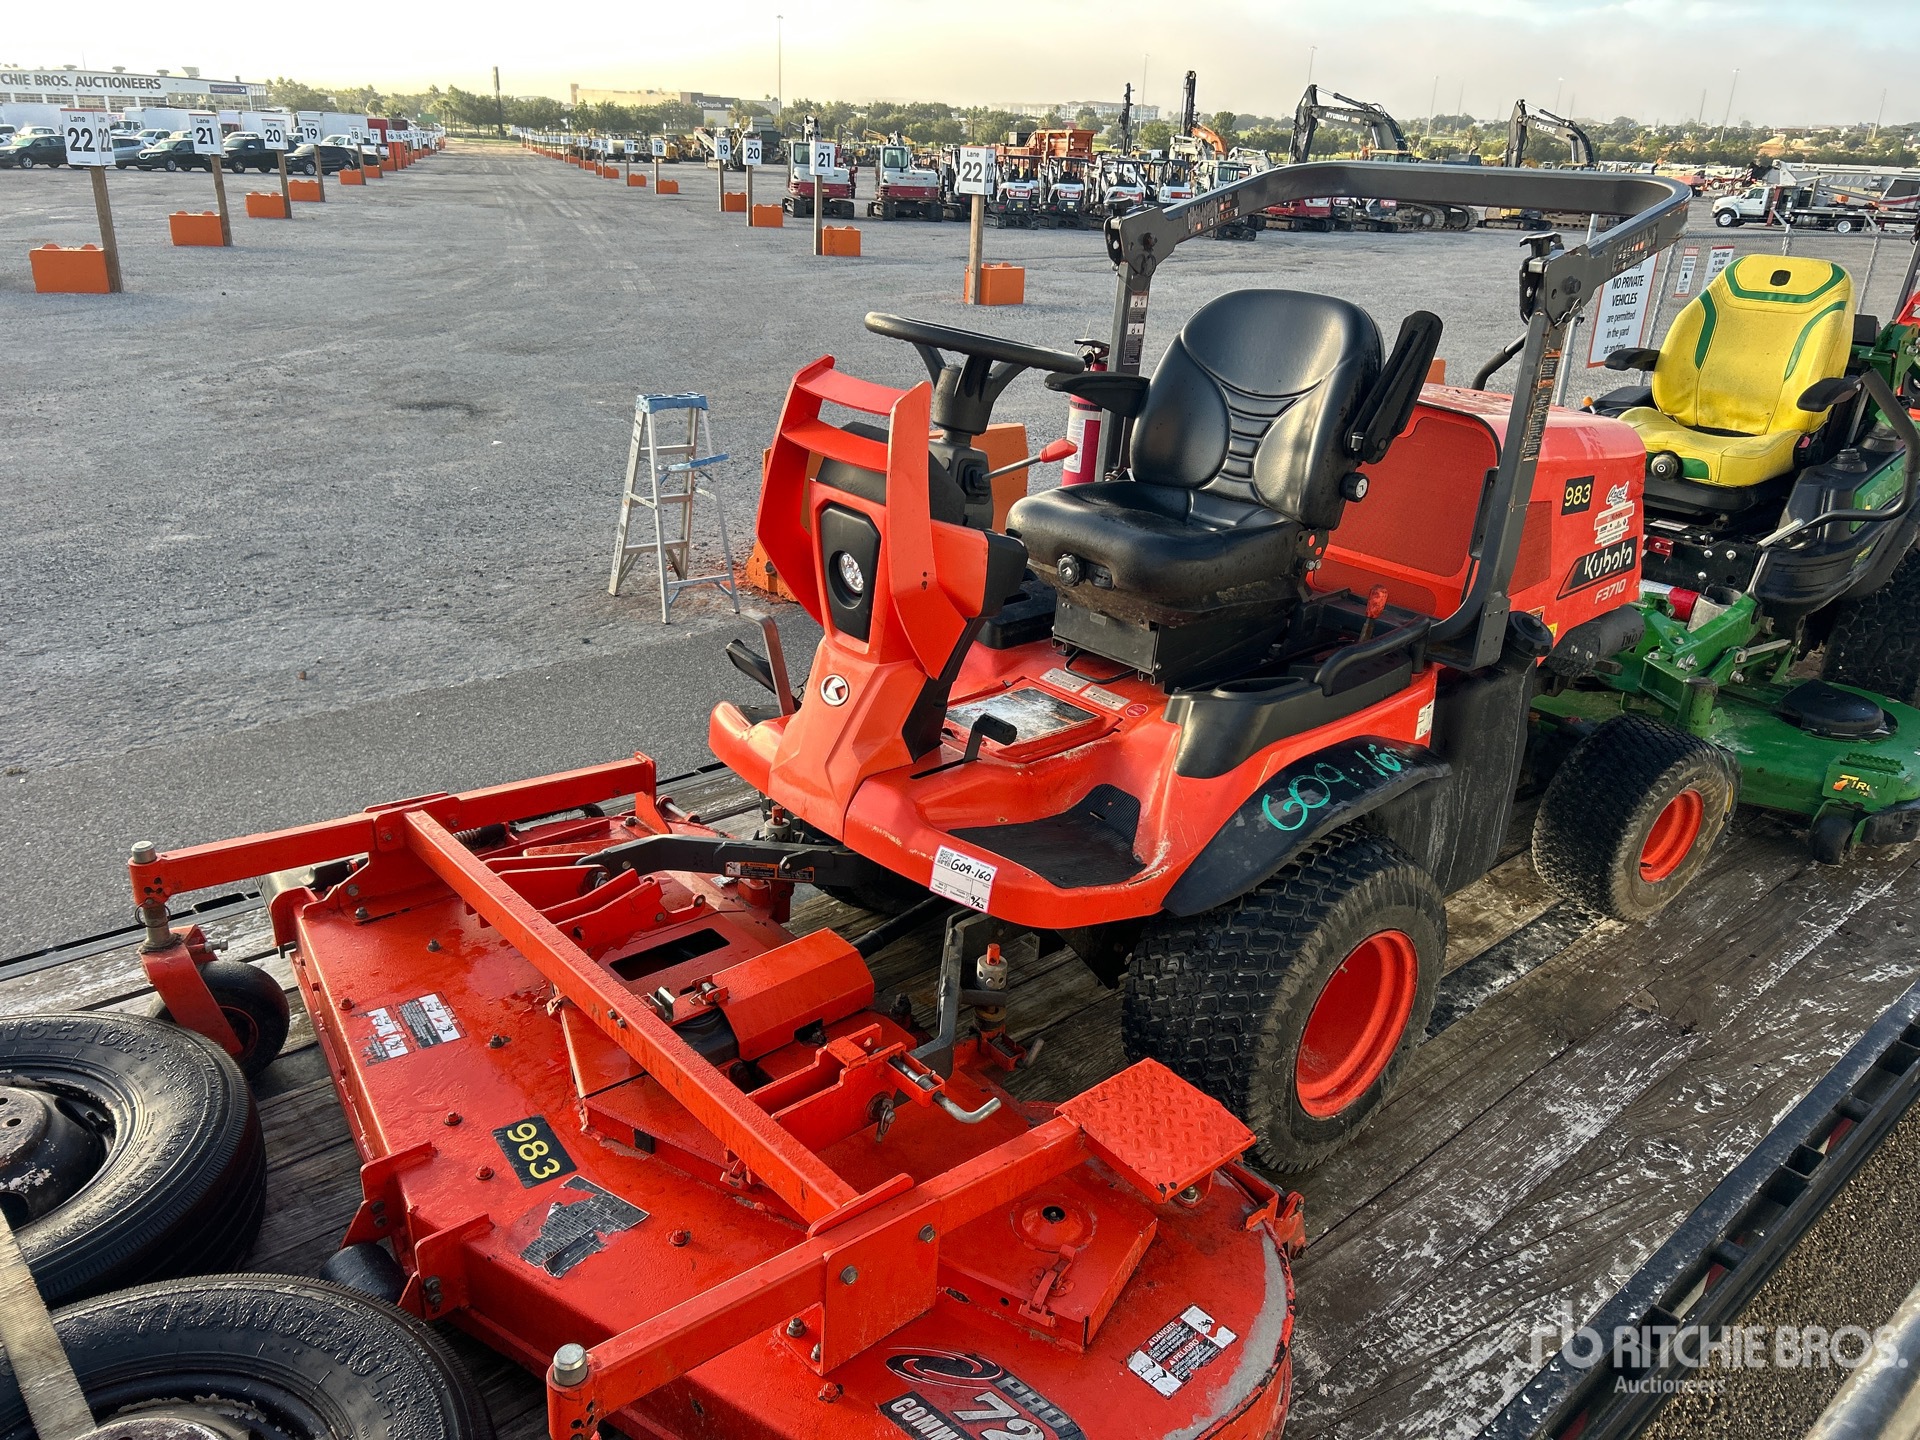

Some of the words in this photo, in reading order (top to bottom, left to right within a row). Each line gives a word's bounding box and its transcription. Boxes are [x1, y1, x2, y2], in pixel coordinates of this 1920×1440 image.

[34, 74, 72, 87] BROS.
[75, 76, 162, 90] AUCTIONEERS
[69, 114, 86, 123] Lane
[1325, 111, 1350, 122] HYUNDAI
[195, 126, 214, 145] 21
[265, 129, 281, 143] 20
[305, 127, 318, 140] 19
[351, 131, 359, 140] 18
[1534, 122, 1557, 135] DEERE
[67, 127, 96, 153] 22
[98, 128, 113, 153] 22
[626, 143, 633, 151] 17
[655, 144, 663, 153] 18
[719, 144, 729, 155] 19
[747, 147, 760, 160] 20
[966, 150, 980, 158] Lane
[818, 151, 831, 168] 21
[962, 161, 983, 183] 22
[1611, 276, 1622, 290] NO
[1621, 274, 1645, 289] PRIVATE
[1611, 292, 1638, 307] VEHICLES
[1606, 314, 1615, 323] are
[1614, 309, 1637, 325] permitted
[1611, 327, 1620, 338] the
[1618, 326, 1631, 340] yard
[1564, 484, 1591, 507] 983
[1583, 541, 1633, 580] Kubota
[1594, 578, 1627, 604] F3710
[950, 858, 992, 882] G09-160
[506, 1122, 561, 1179] 983
[1151, 1321, 1178, 1343] DANGER
[1173, 1338, 1200, 1362] PELIGRO
[953, 1391, 1045, 1440] 72
